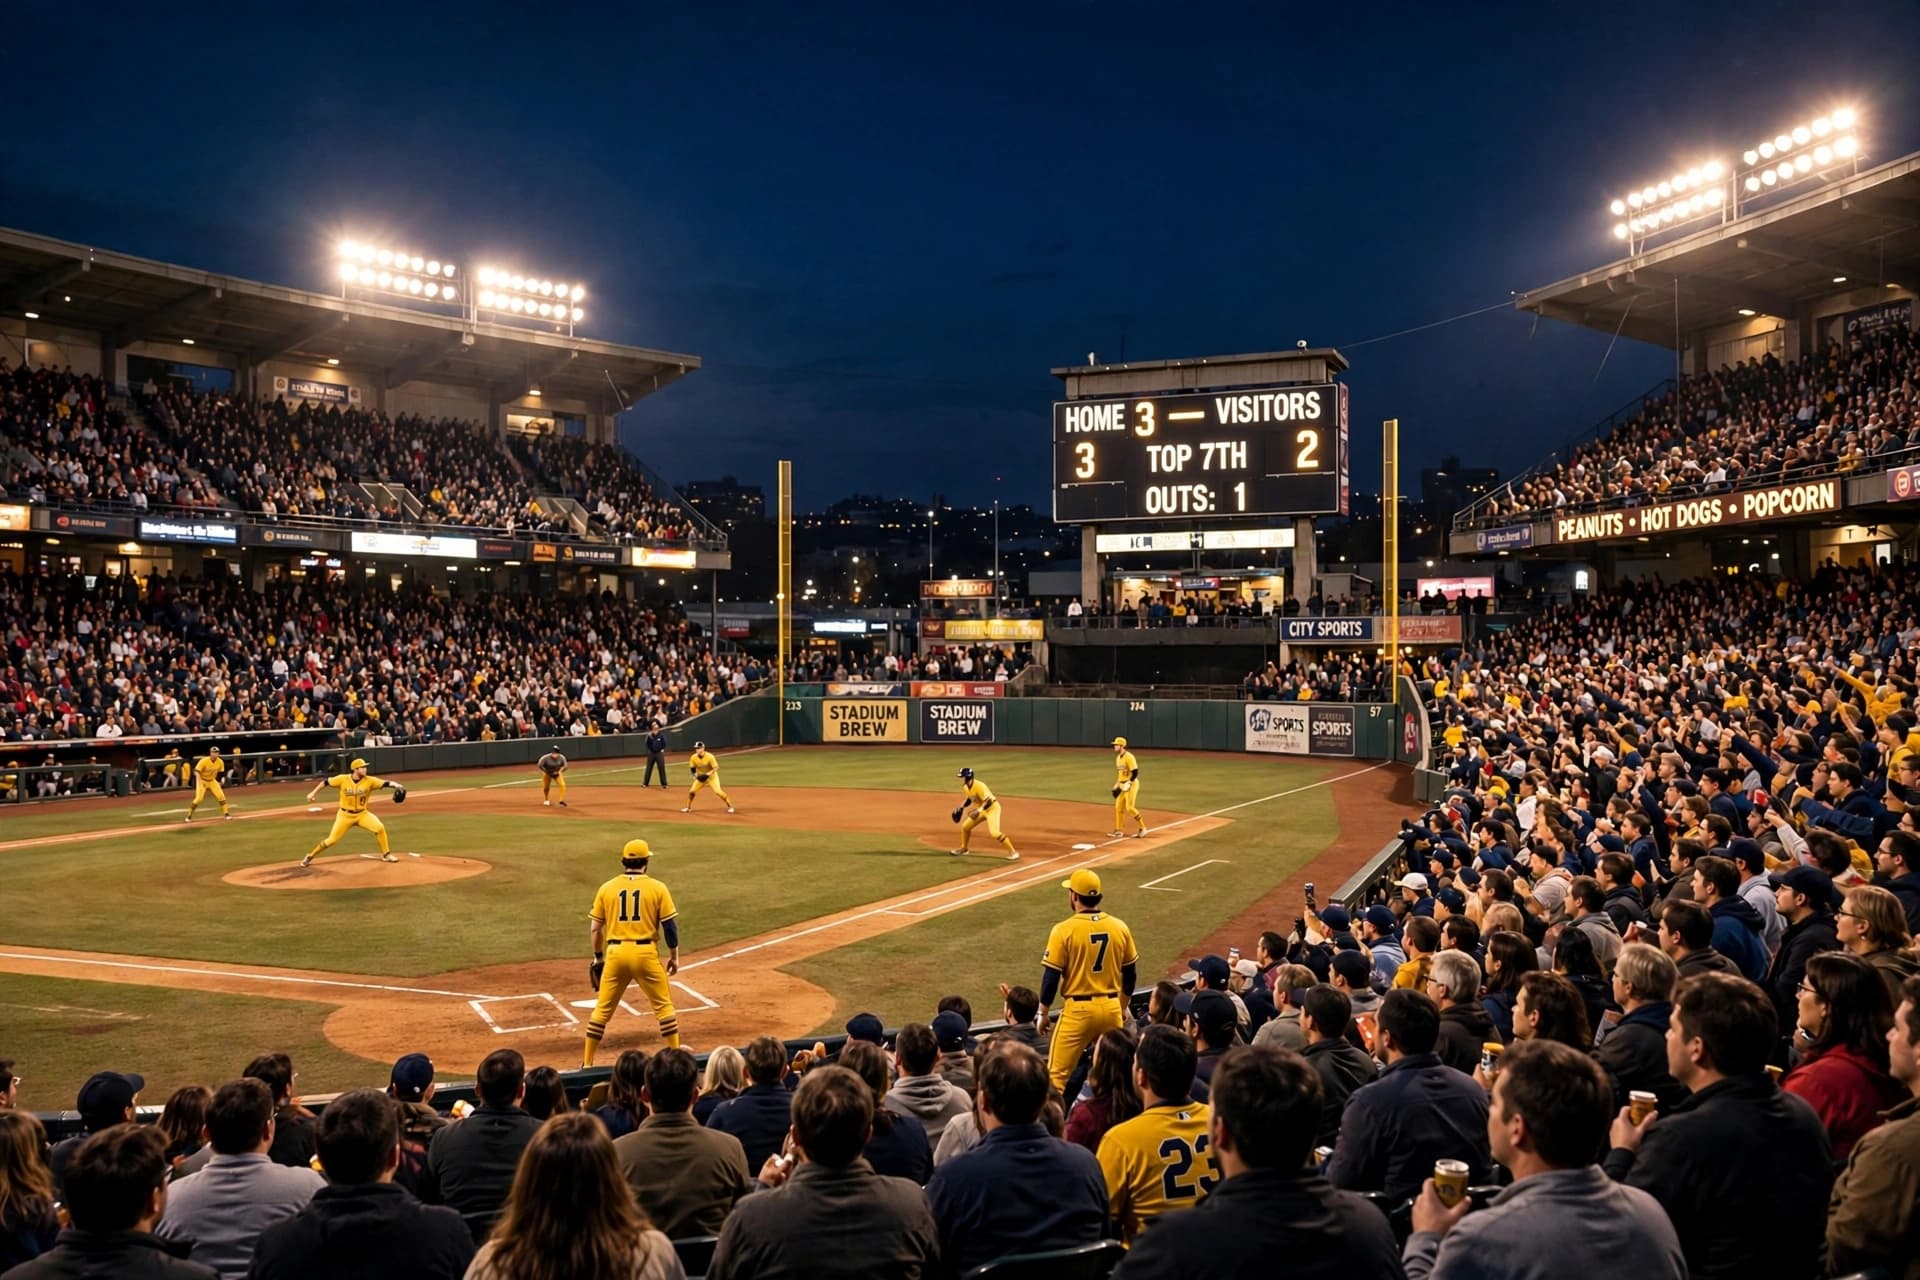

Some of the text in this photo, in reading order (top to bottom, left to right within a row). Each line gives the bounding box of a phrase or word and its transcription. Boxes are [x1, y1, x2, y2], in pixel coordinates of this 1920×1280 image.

[1065, 404, 1125, 432] HOME
[1135, 402, 1154, 436] 3
[1216, 392, 1320, 424] VISITORS
[1075, 442, 1095, 478] 3
[1146, 441, 1247, 472] TOP 7TH
[1296, 430, 1319, 468] 2
[1146, 482, 1245, 513] OUTS: 1
[1558, 482, 1835, 541] PEANUTS HOT DOGS POPCORN
[1289, 620, 1362, 637] CITY SPORTS
[830, 705, 899, 720] STADIUM
[930, 705, 987, 719] STADIUM
[938, 720, 980, 735] BREW
[840, 722, 887, 736] BREW
[1312, 721, 1352, 736] SPORTS
[619, 889, 640, 921] 11
[1090, 933, 1109, 972] 7
